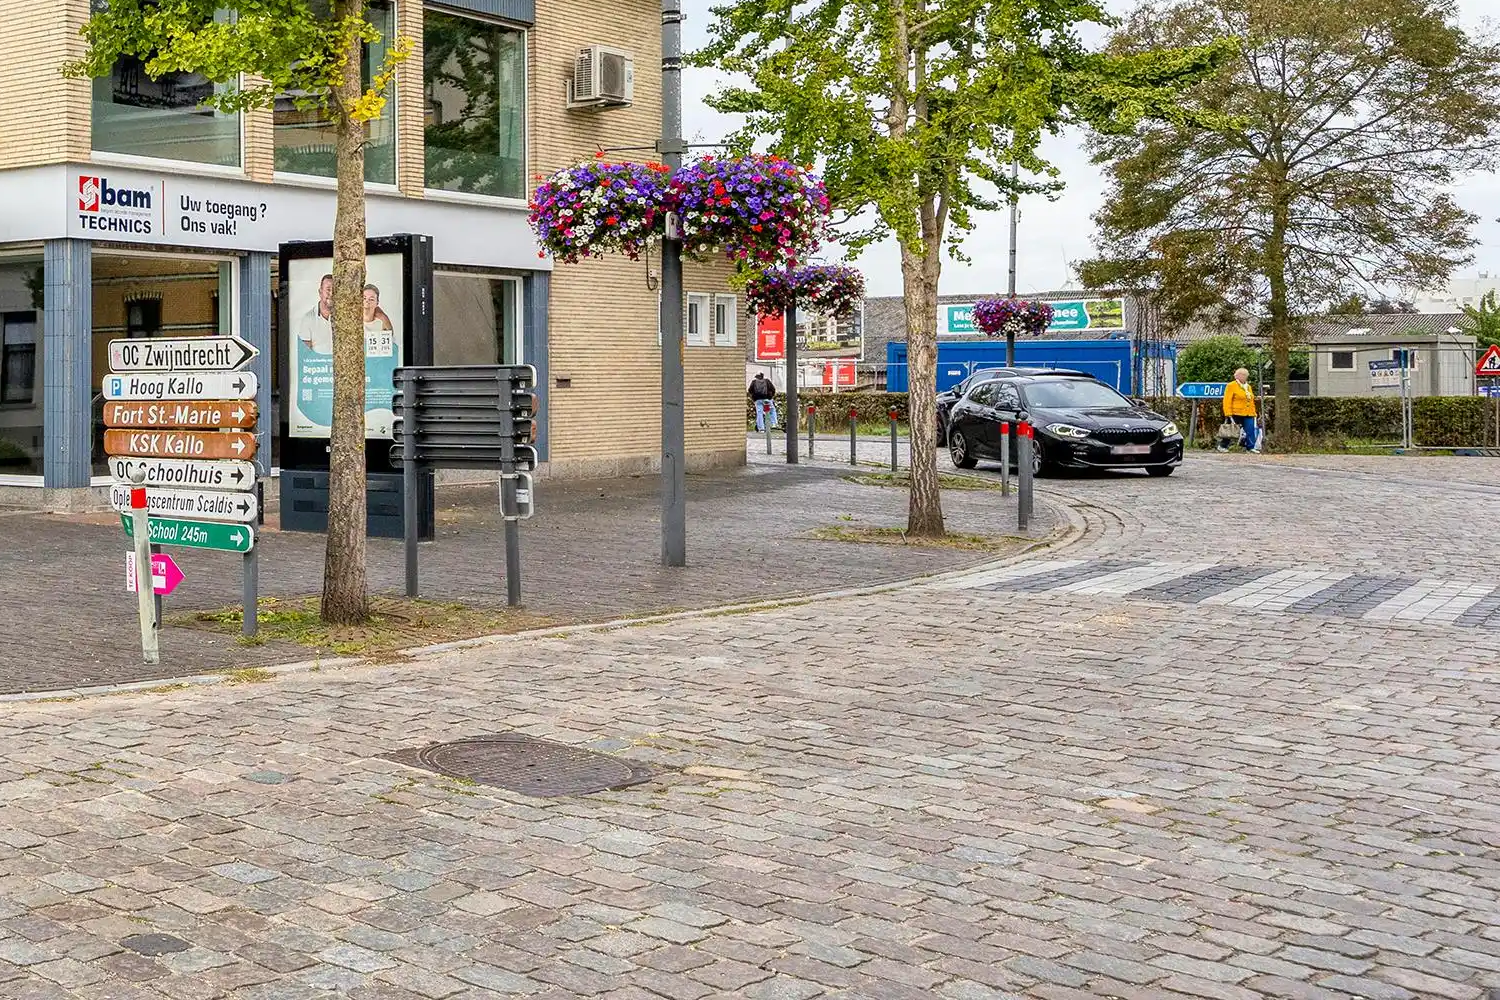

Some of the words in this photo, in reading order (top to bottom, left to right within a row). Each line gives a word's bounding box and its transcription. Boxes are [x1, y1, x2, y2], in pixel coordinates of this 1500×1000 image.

[101, 179, 151, 209] bam
[180, 195, 201, 212] Uw
[79, 215, 152, 234] TECHNICS
[181, 216, 206, 233] Ons
[211, 220, 237, 236] vak!
[123, 345, 139, 366] OC
[145, 343, 231, 371] Zwijndrecht
[130, 378, 164, 398] Hoog
[168, 378, 203, 395] Kallo
[1204, 385, 1222, 395] Doel
[113, 405, 143, 424] Fort
[148, 405, 221, 425] St.-Marie
[129, 433, 160, 453] KSK
[164, 434, 204, 454] Kallo
[113, 489, 194, 512] Oplegscentrum
[197, 495, 234, 514] Scaldis
[148, 521, 177, 540] School
[181, 527, 208, 543] 245m
